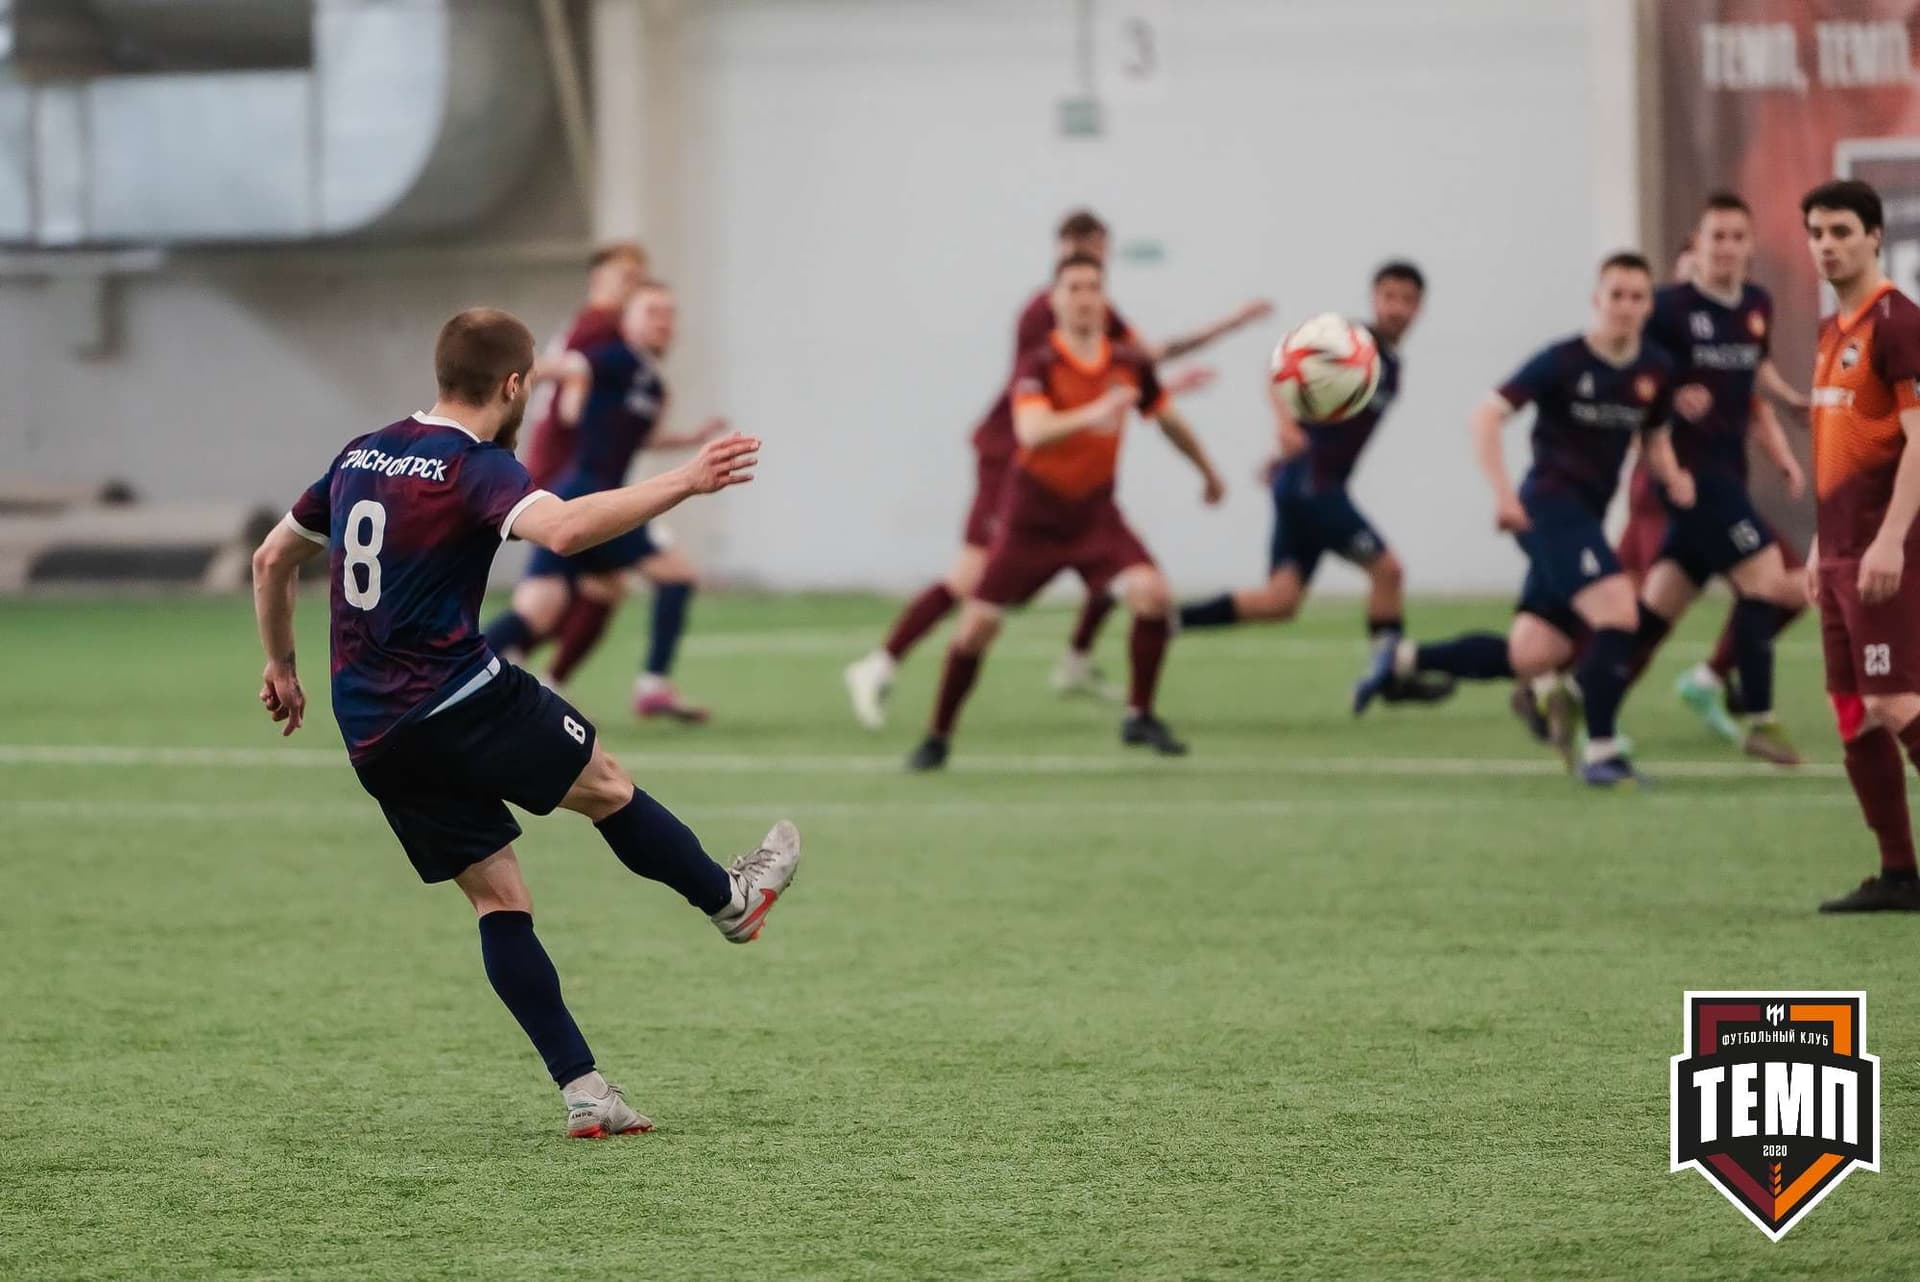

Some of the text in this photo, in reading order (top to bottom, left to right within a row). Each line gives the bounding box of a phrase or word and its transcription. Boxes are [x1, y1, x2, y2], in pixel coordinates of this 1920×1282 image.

[1121, 16, 1157, 82] 3
[343, 499, 387, 611] 8
[1864, 643, 1891, 676] 23
[563, 714, 587, 745] 8
